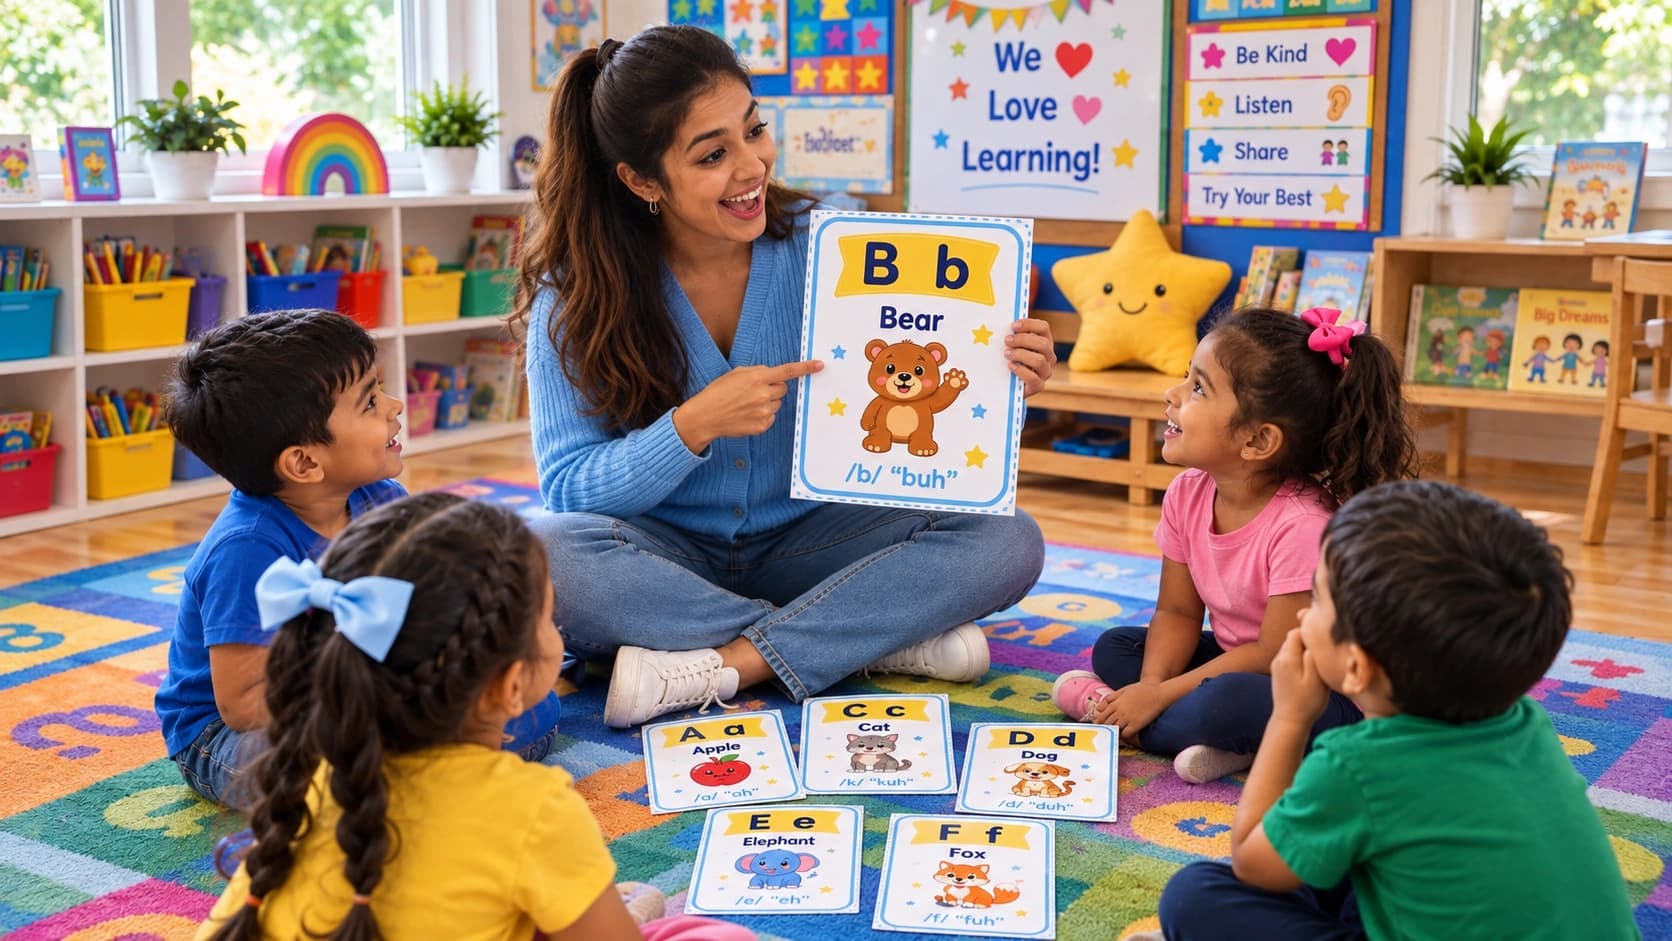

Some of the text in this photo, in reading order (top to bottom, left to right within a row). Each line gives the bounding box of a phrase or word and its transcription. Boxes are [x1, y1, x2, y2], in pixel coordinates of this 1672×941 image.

[995, 42, 1041, 72] We
[1236, 43, 1307, 65] Be Kind
[989, 90, 1057, 120] Love
[1236, 96, 1292, 114] Listen
[1235, 142, 1288, 160] Share
[963, 141, 1099, 182] Learning!
[1202, 187, 1312, 208] Try Your Best
[864, 242, 969, 289] B b
[880, 306, 944, 331] Bear
[1534, 308, 1609, 325] Big Dreams
[845, 463, 957, 489] /b/ “buh”
[842, 703, 905, 718] C c
[680, 725, 745, 742] A a
[858, 723, 890, 731] Cat
[1009, 731, 1076, 747] D d
[692, 742, 741, 756] Apple
[1022, 751, 1057, 762] Dog
[839, 777, 914, 787] /k/ "kuh"
[694, 787, 760, 803] /a/ "ah"
[998, 799, 1074, 812] /d/ "duh"
[750, 814, 815, 830] E e
[940, 824, 1003, 843] F f
[742, 836, 816, 848] Elephant
[950, 848, 986, 859] Fox
[735, 894, 810, 905] /e/ "eh"
[923, 912, 1005, 926] /f/ "fuh"
